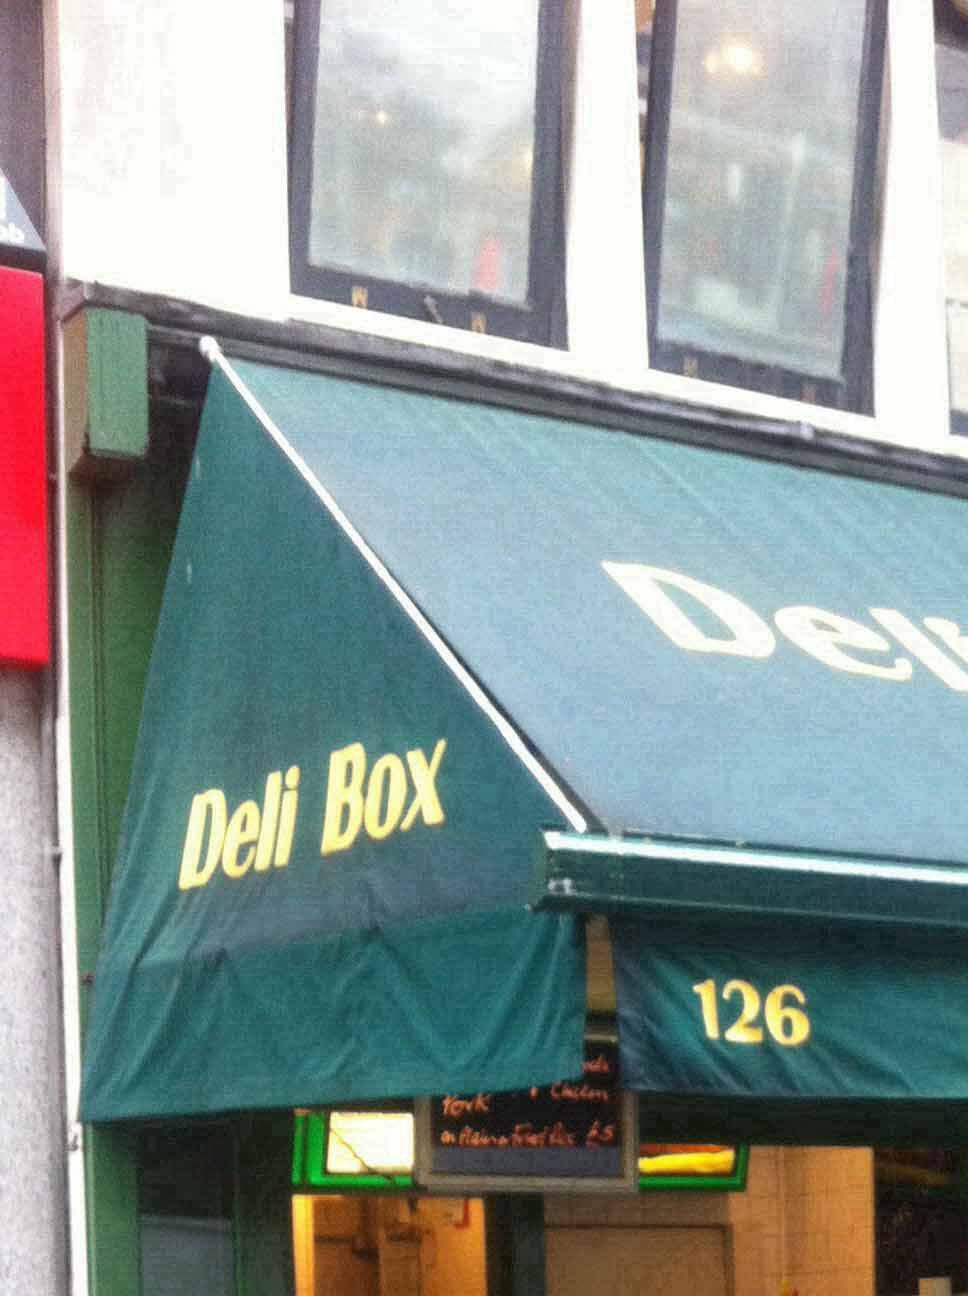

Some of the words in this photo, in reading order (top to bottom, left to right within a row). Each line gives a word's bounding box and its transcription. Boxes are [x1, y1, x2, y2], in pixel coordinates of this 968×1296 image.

[178, 764, 300, 891] Deli
[320, 738, 448, 857] Box
[692, 978, 811, 1046] 126
